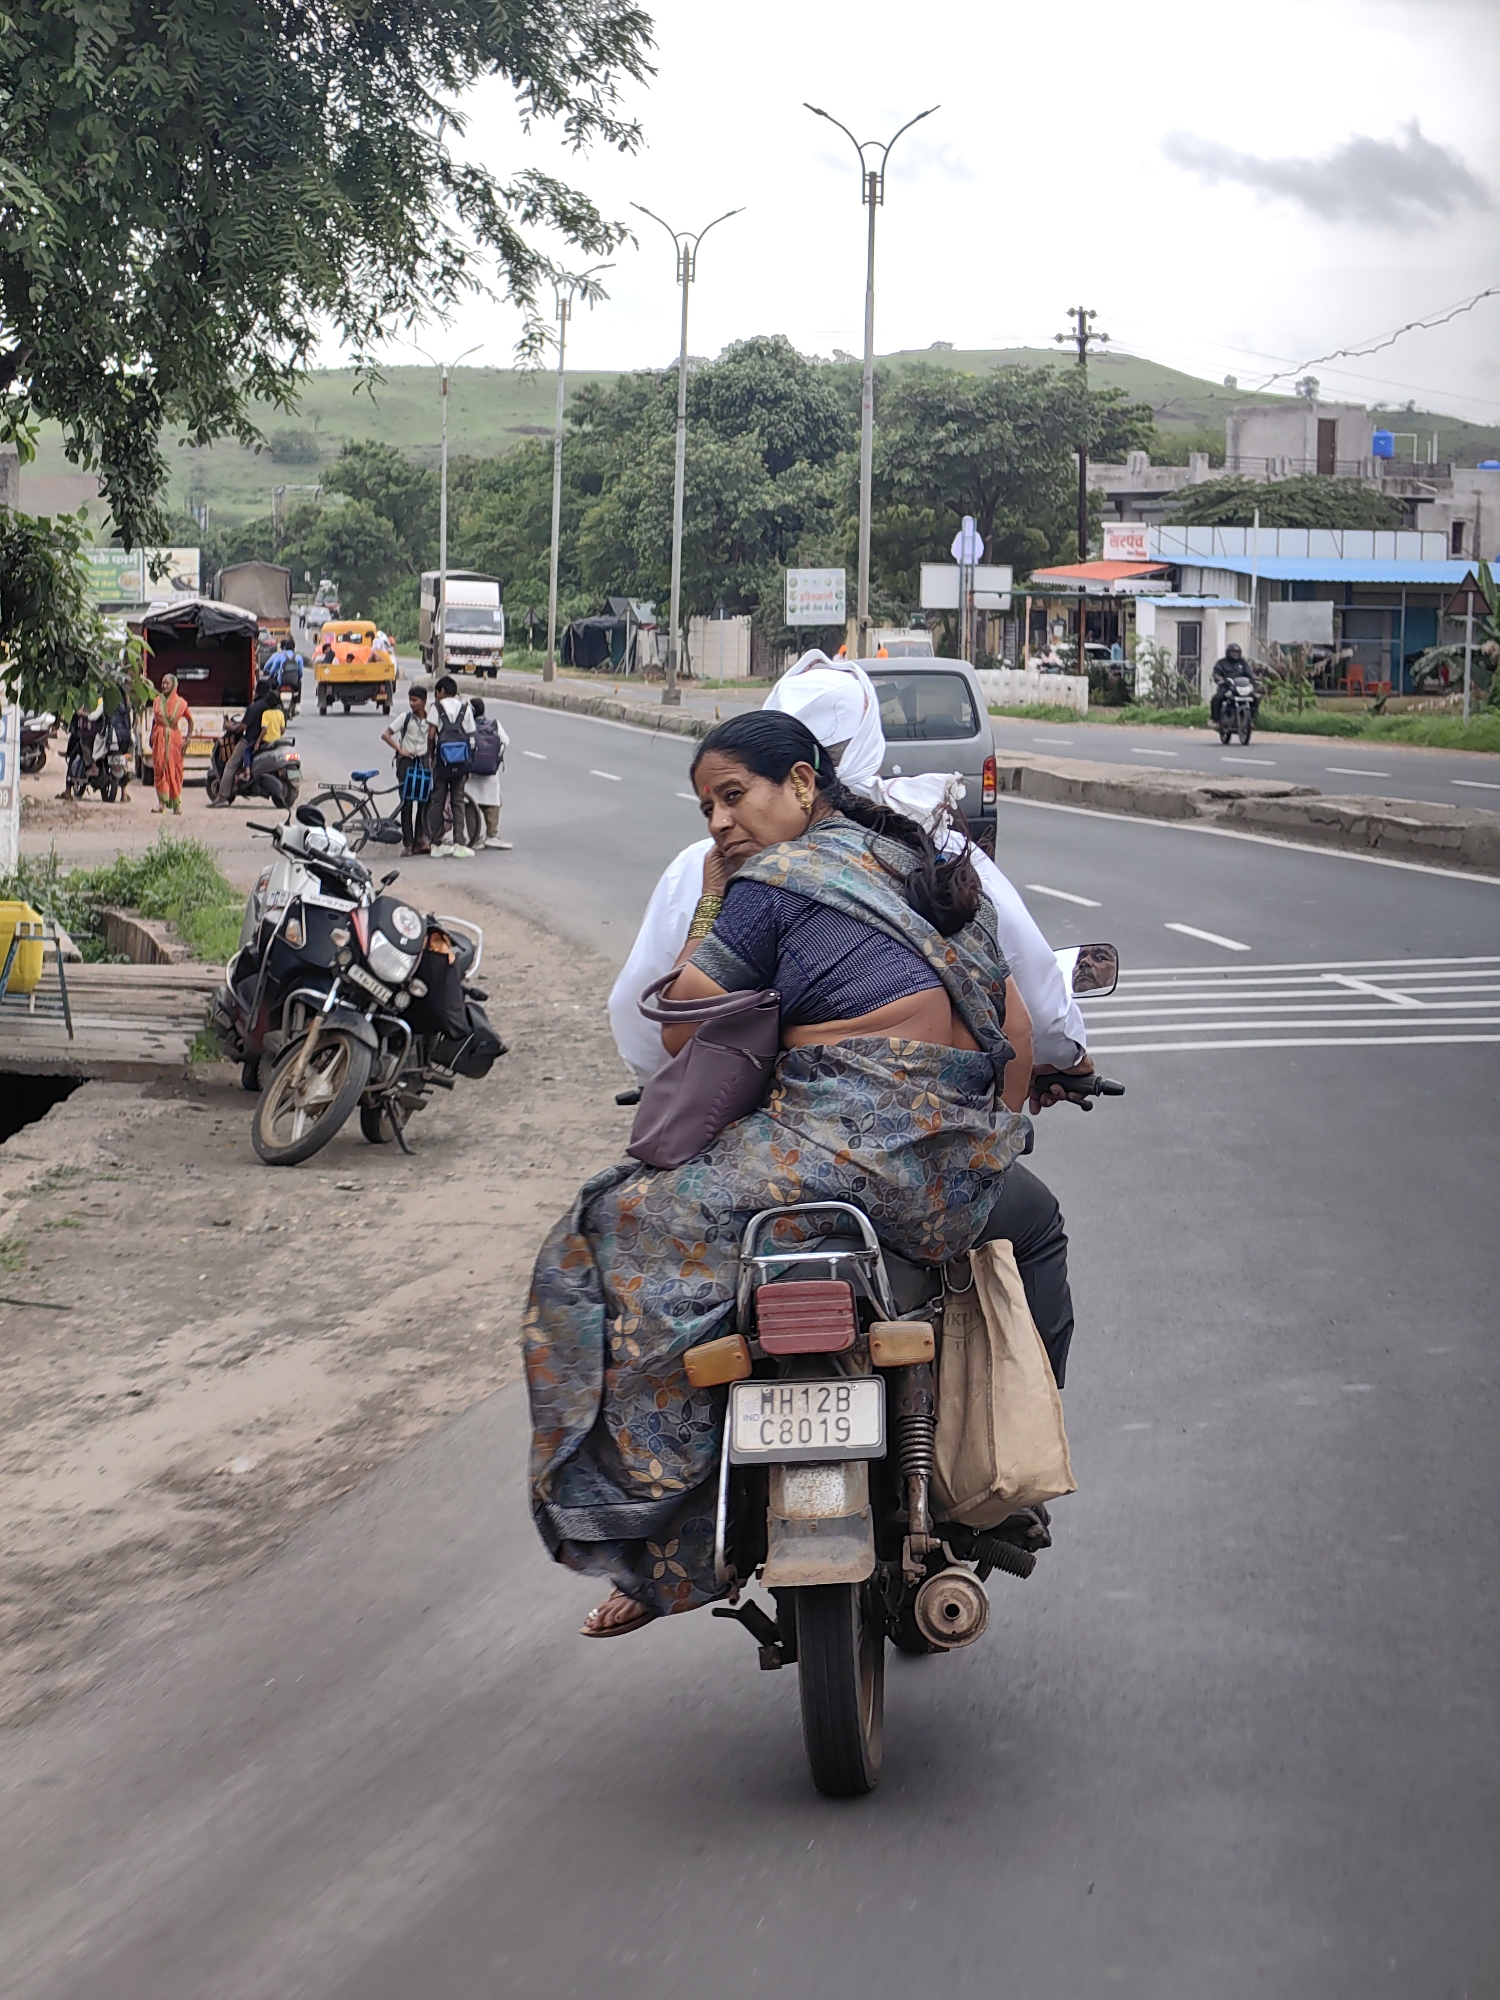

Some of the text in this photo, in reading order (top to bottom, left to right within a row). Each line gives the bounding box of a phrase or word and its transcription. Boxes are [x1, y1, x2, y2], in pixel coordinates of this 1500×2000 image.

[1109, 529, 1144, 548] सरपंच
[760, 1386, 850, 1415] MH12B
[742, 1413, 760, 1422] IND
[760, 1416, 850, 1446] C8019
